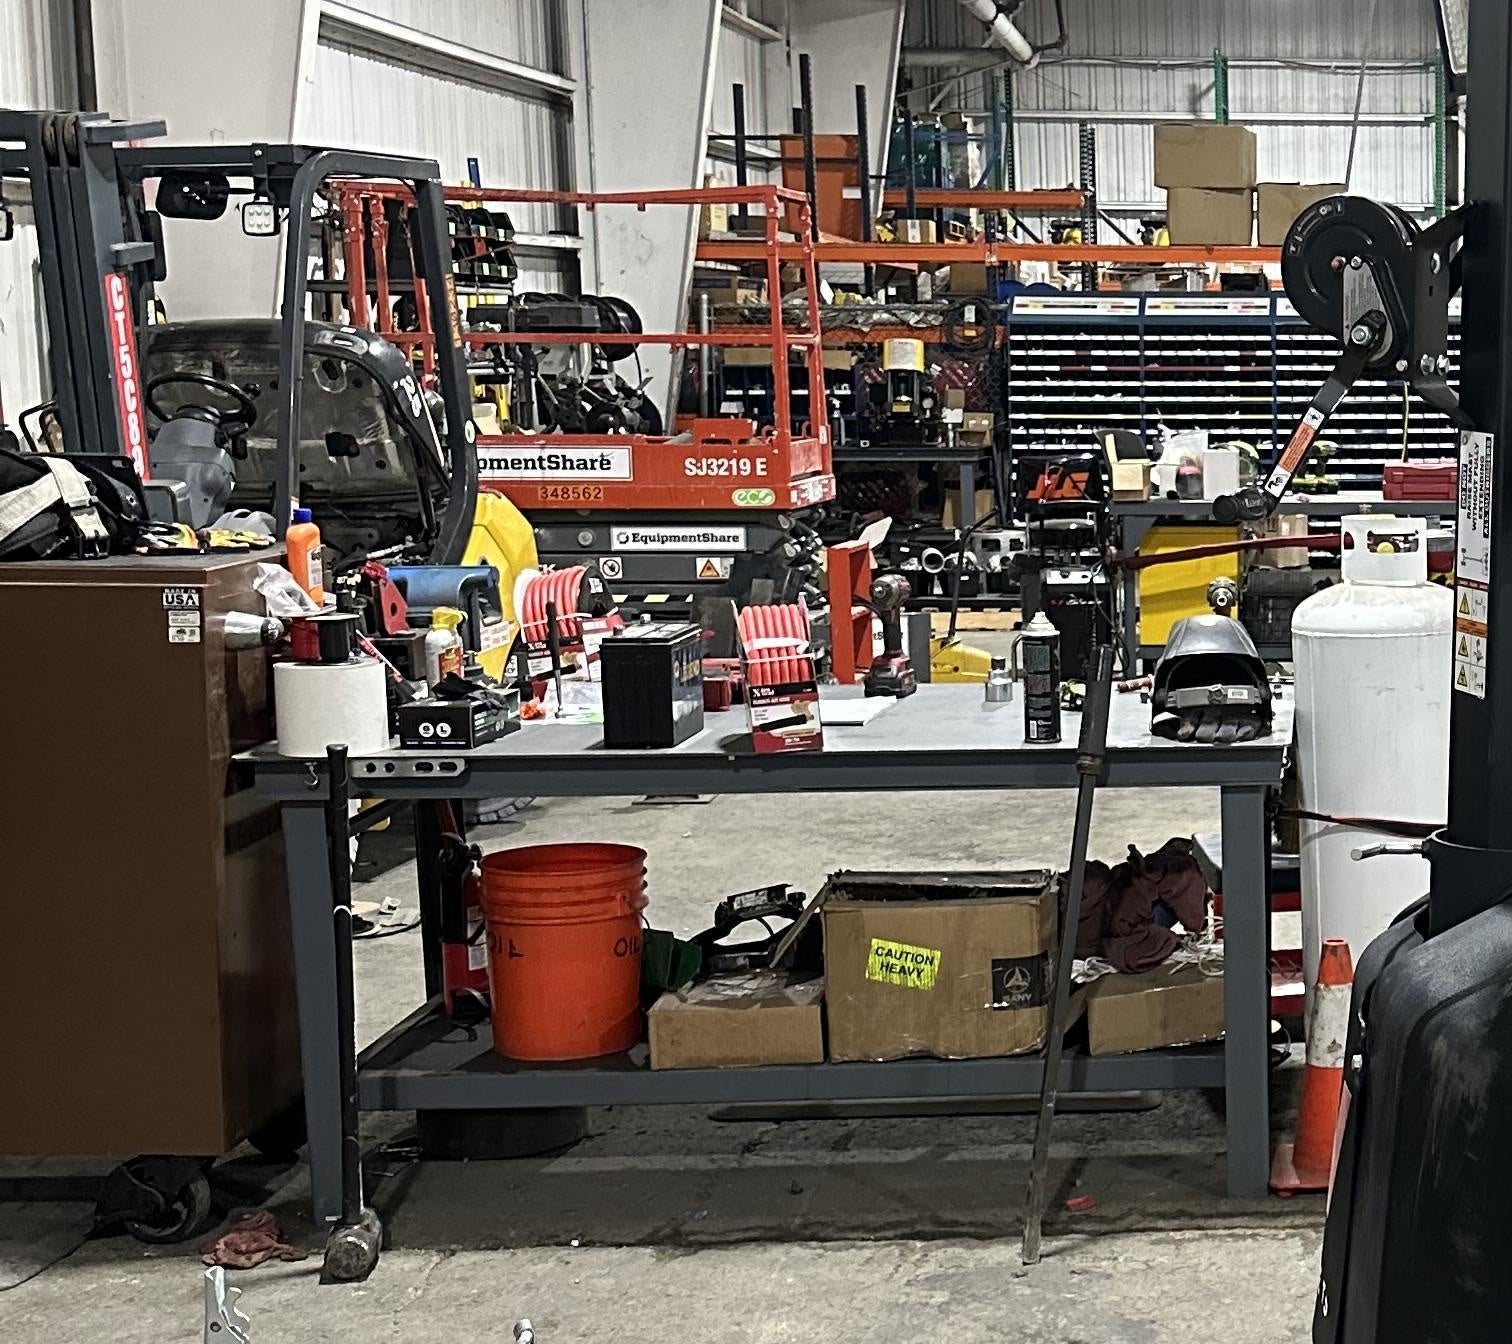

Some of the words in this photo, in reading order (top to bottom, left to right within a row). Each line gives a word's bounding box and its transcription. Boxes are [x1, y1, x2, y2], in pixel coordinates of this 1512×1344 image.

[477, 453, 612, 475] pmentShare
[684, 457, 752, 476] SJ3219
[755, 457, 768, 476] E
[1472, 442, 1480, 477] FULLY
[539, 487, 602, 500] 348562
[1471, 479, 1479, 531] WITHOUT
[632, 532, 740, 545] EquipmentShare
[165, 594, 196, 605] USA
[875, 946, 935, 967] CAUTION
[880, 962, 925, 978] HEAVY
